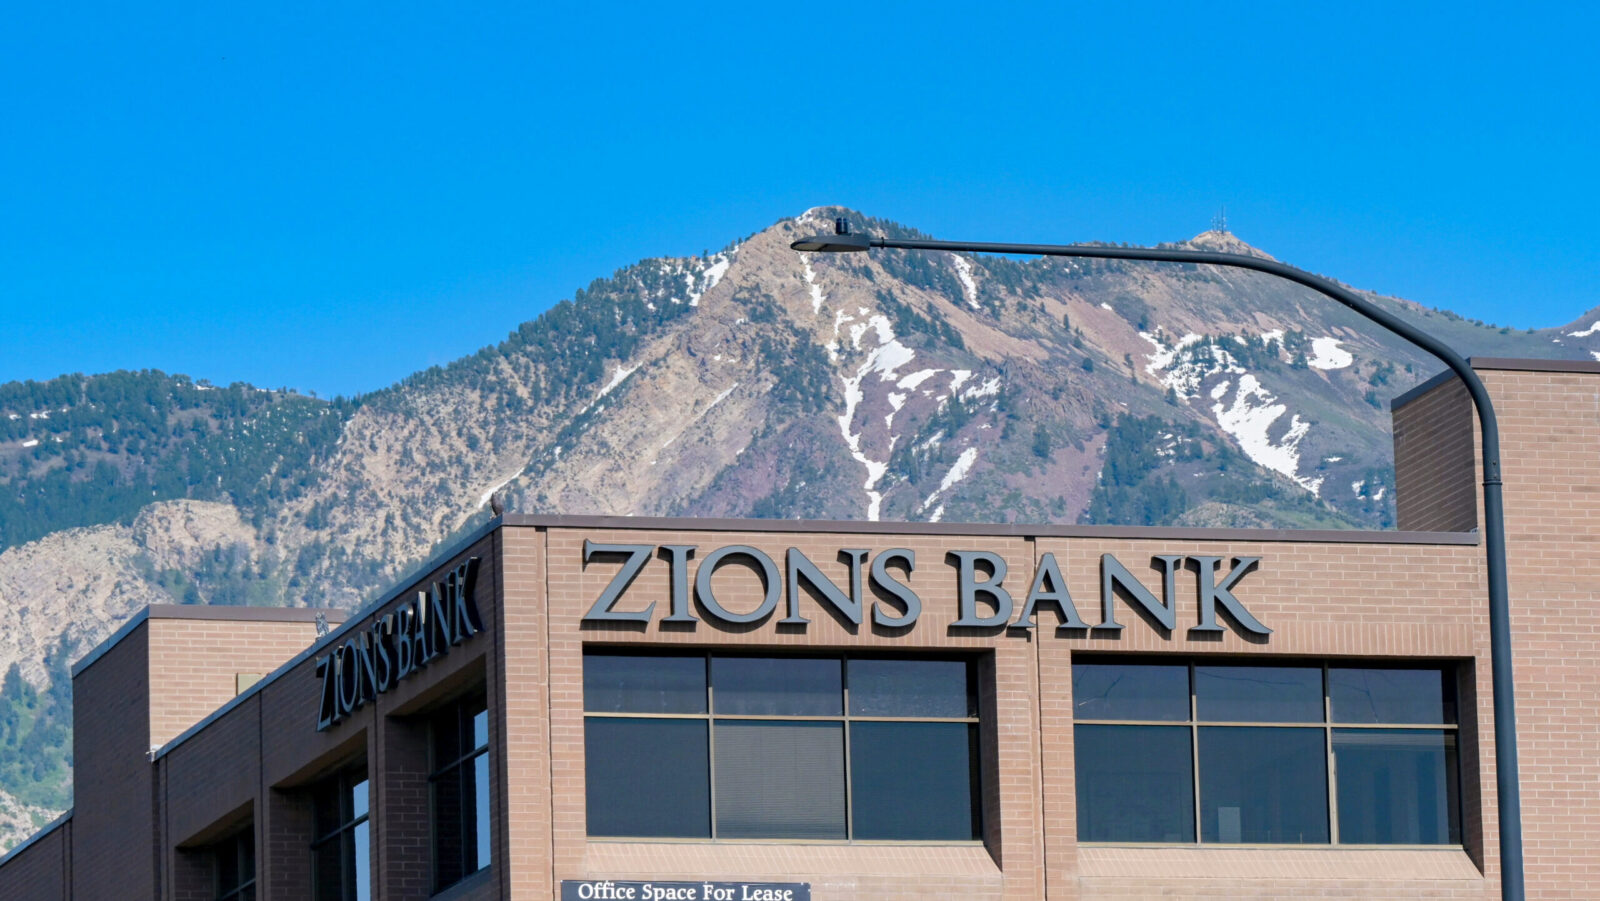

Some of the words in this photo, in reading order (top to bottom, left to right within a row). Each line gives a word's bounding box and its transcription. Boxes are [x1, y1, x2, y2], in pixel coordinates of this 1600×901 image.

[580, 538, 922, 629] ZIONS
[947, 550, 1274, 636] BANK
[316, 614, 393, 732] ZIONS
[396, 557, 483, 681] BANK
[578, 883, 636, 900] Office
[642, 884, 696, 901] Space
[703, 884, 735, 901] For
[741, 885, 793, 901] Lease
